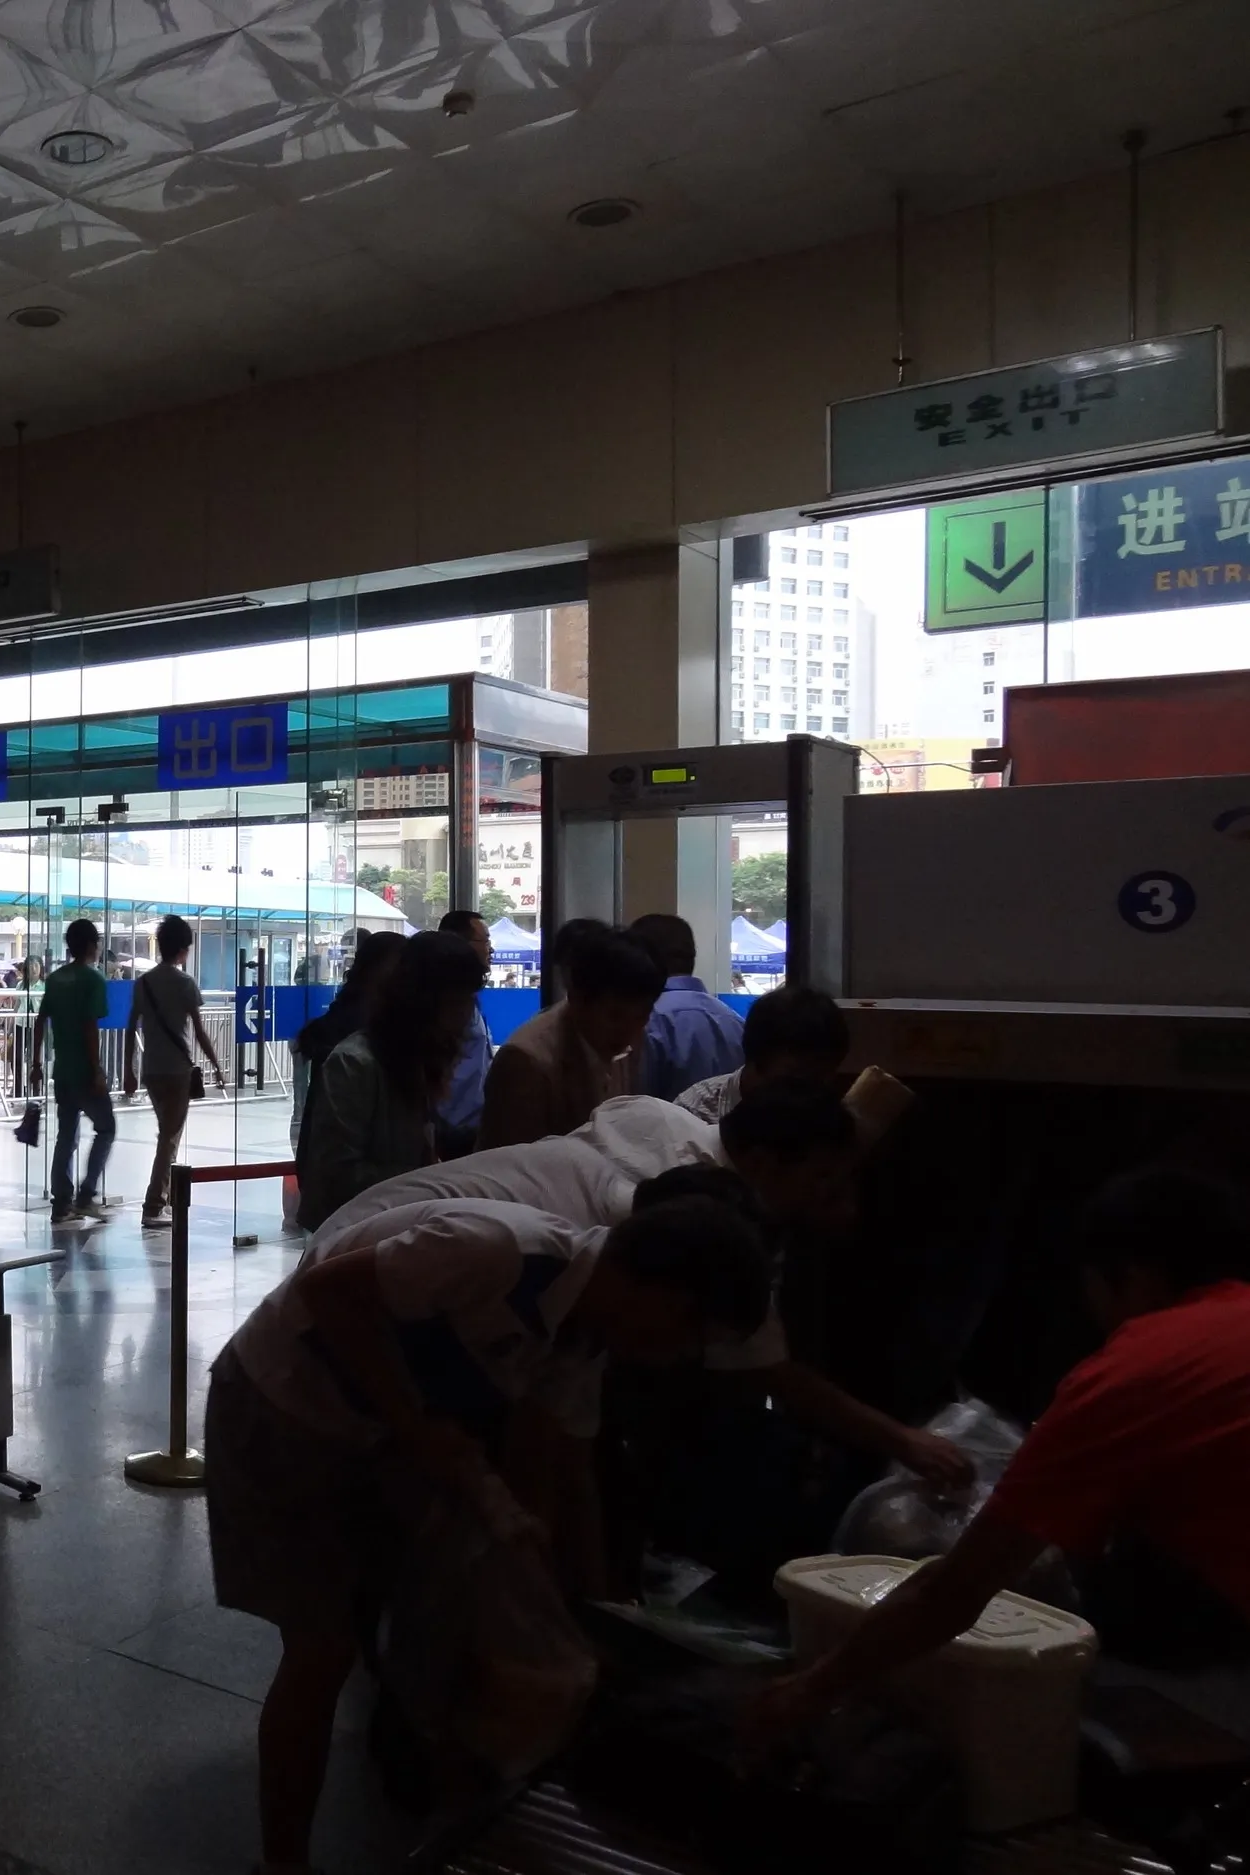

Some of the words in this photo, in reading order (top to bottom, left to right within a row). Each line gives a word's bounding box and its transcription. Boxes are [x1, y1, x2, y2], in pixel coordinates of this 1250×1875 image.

[913, 373, 1119, 432] 安全出口
[937, 408, 1091, 447] EXIT
[172, 717, 273, 779] 出口
[1136, 879, 1178, 926] 3
